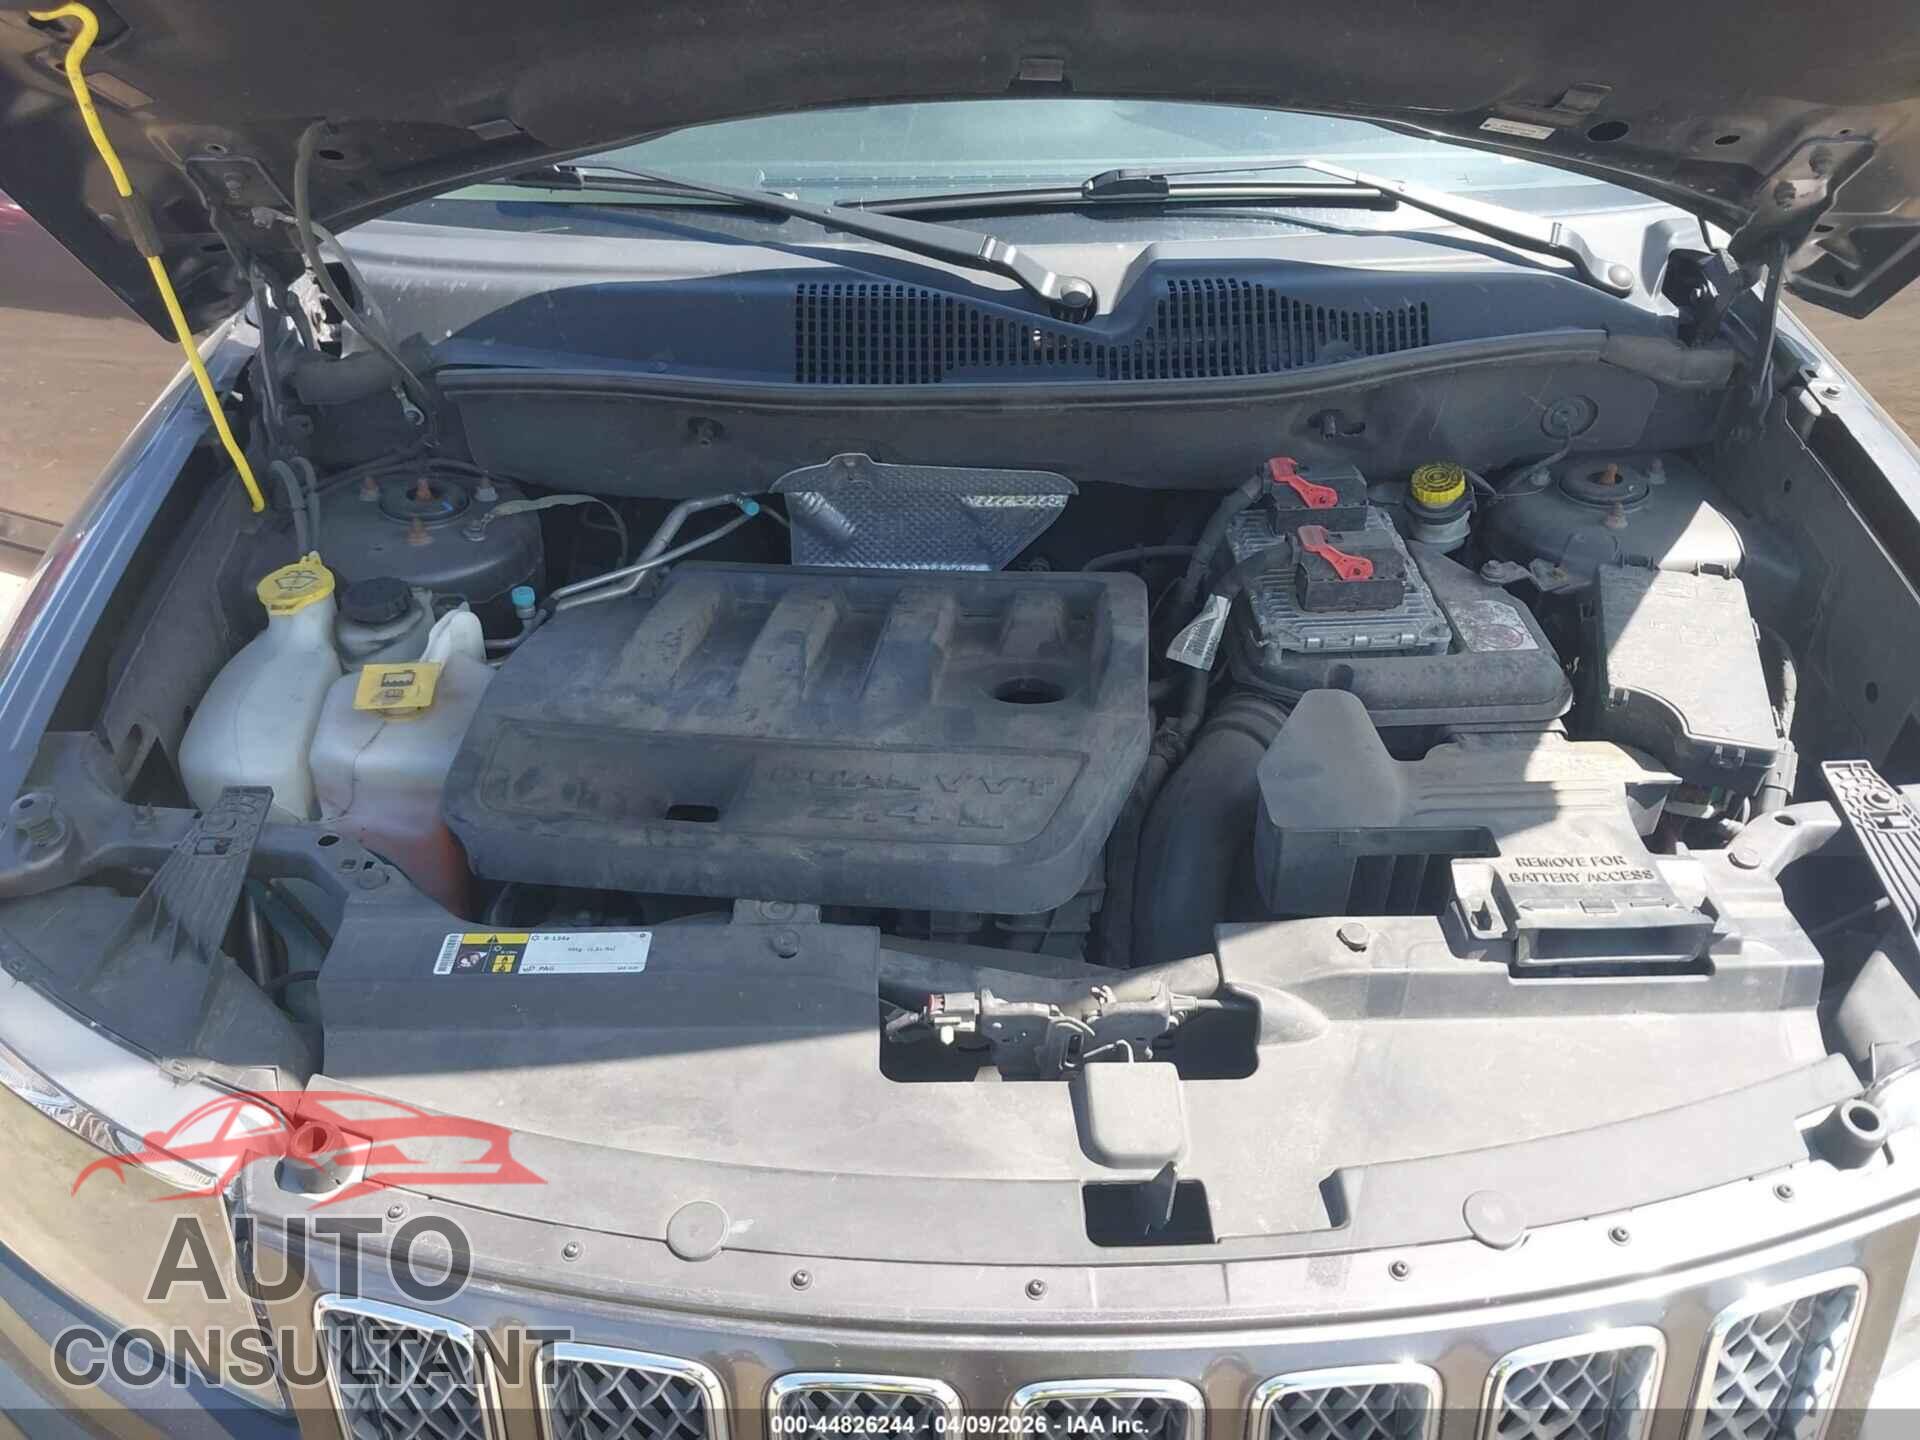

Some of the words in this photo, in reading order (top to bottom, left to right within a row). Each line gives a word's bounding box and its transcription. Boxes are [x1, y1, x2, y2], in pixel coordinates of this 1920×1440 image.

[1514, 855, 1590, 868] REMOVE
[1591, 855, 1628, 867] FOR
[1508, 871, 1580, 884] BATTERY
[1586, 869, 1655, 883] ACCESS
